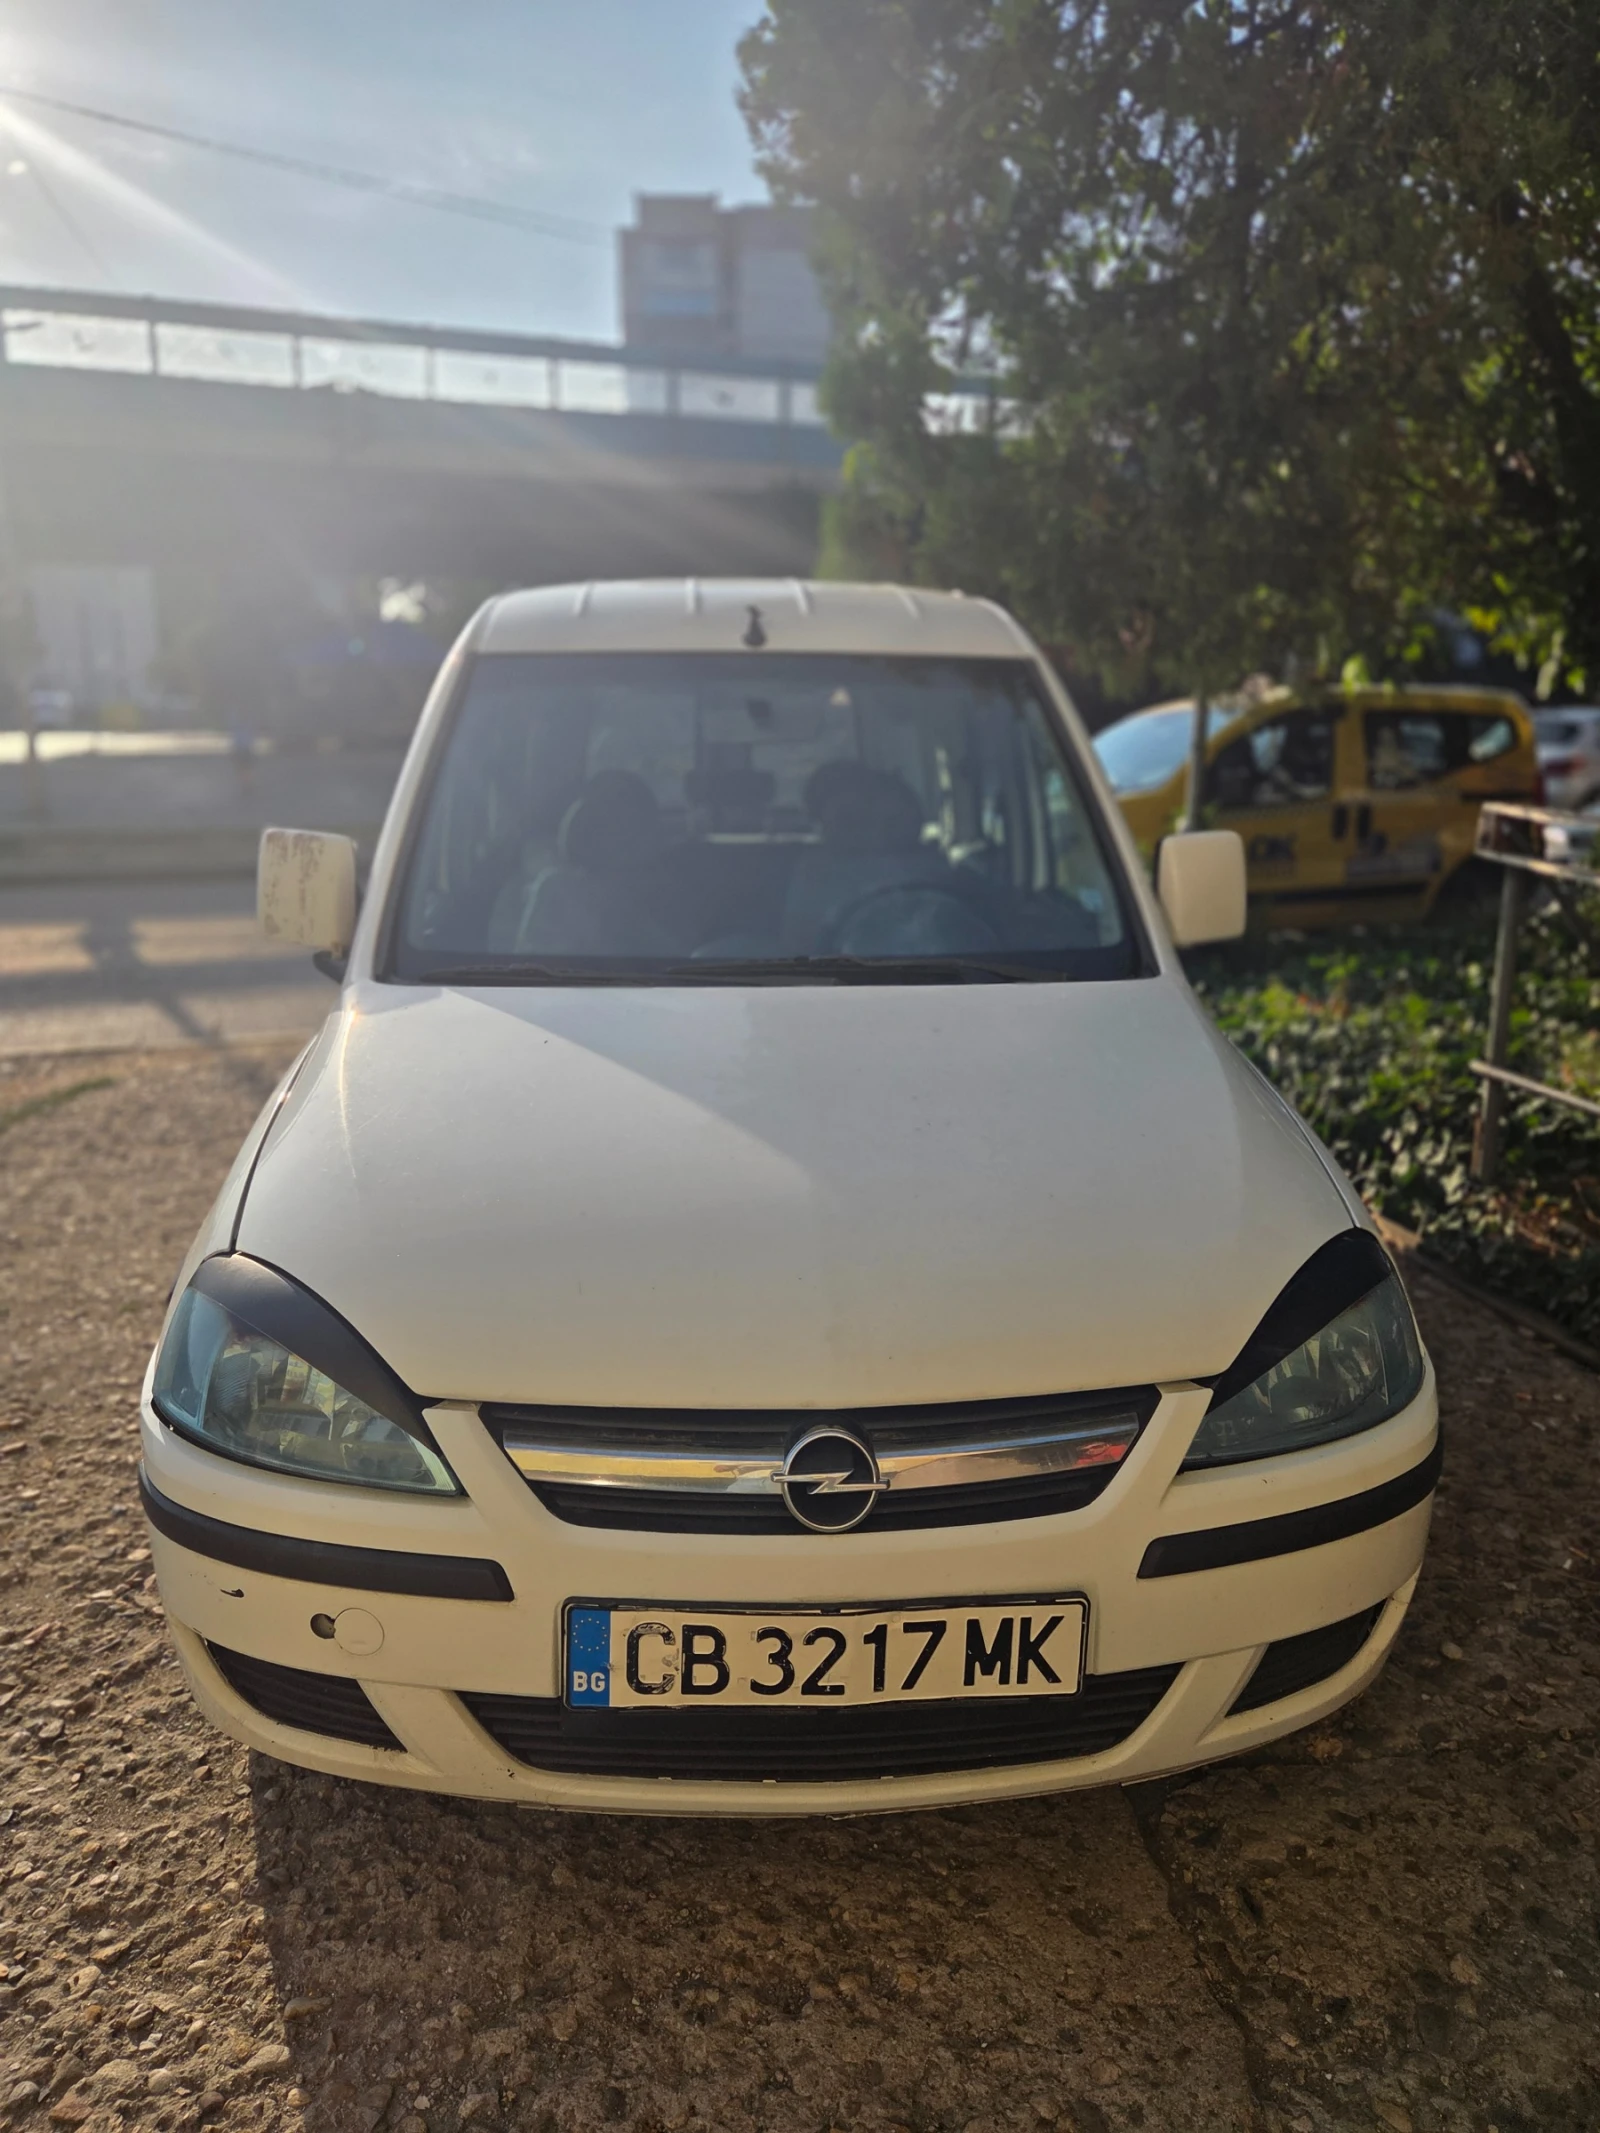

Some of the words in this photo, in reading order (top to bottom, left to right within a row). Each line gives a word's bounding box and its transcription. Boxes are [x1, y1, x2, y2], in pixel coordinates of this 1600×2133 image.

[626, 1622, 730, 1695] CB
[750, 1620, 947, 1695] 3217
[963, 1616, 1065, 1686] MK
[573, 1671, 606, 1692] BG
